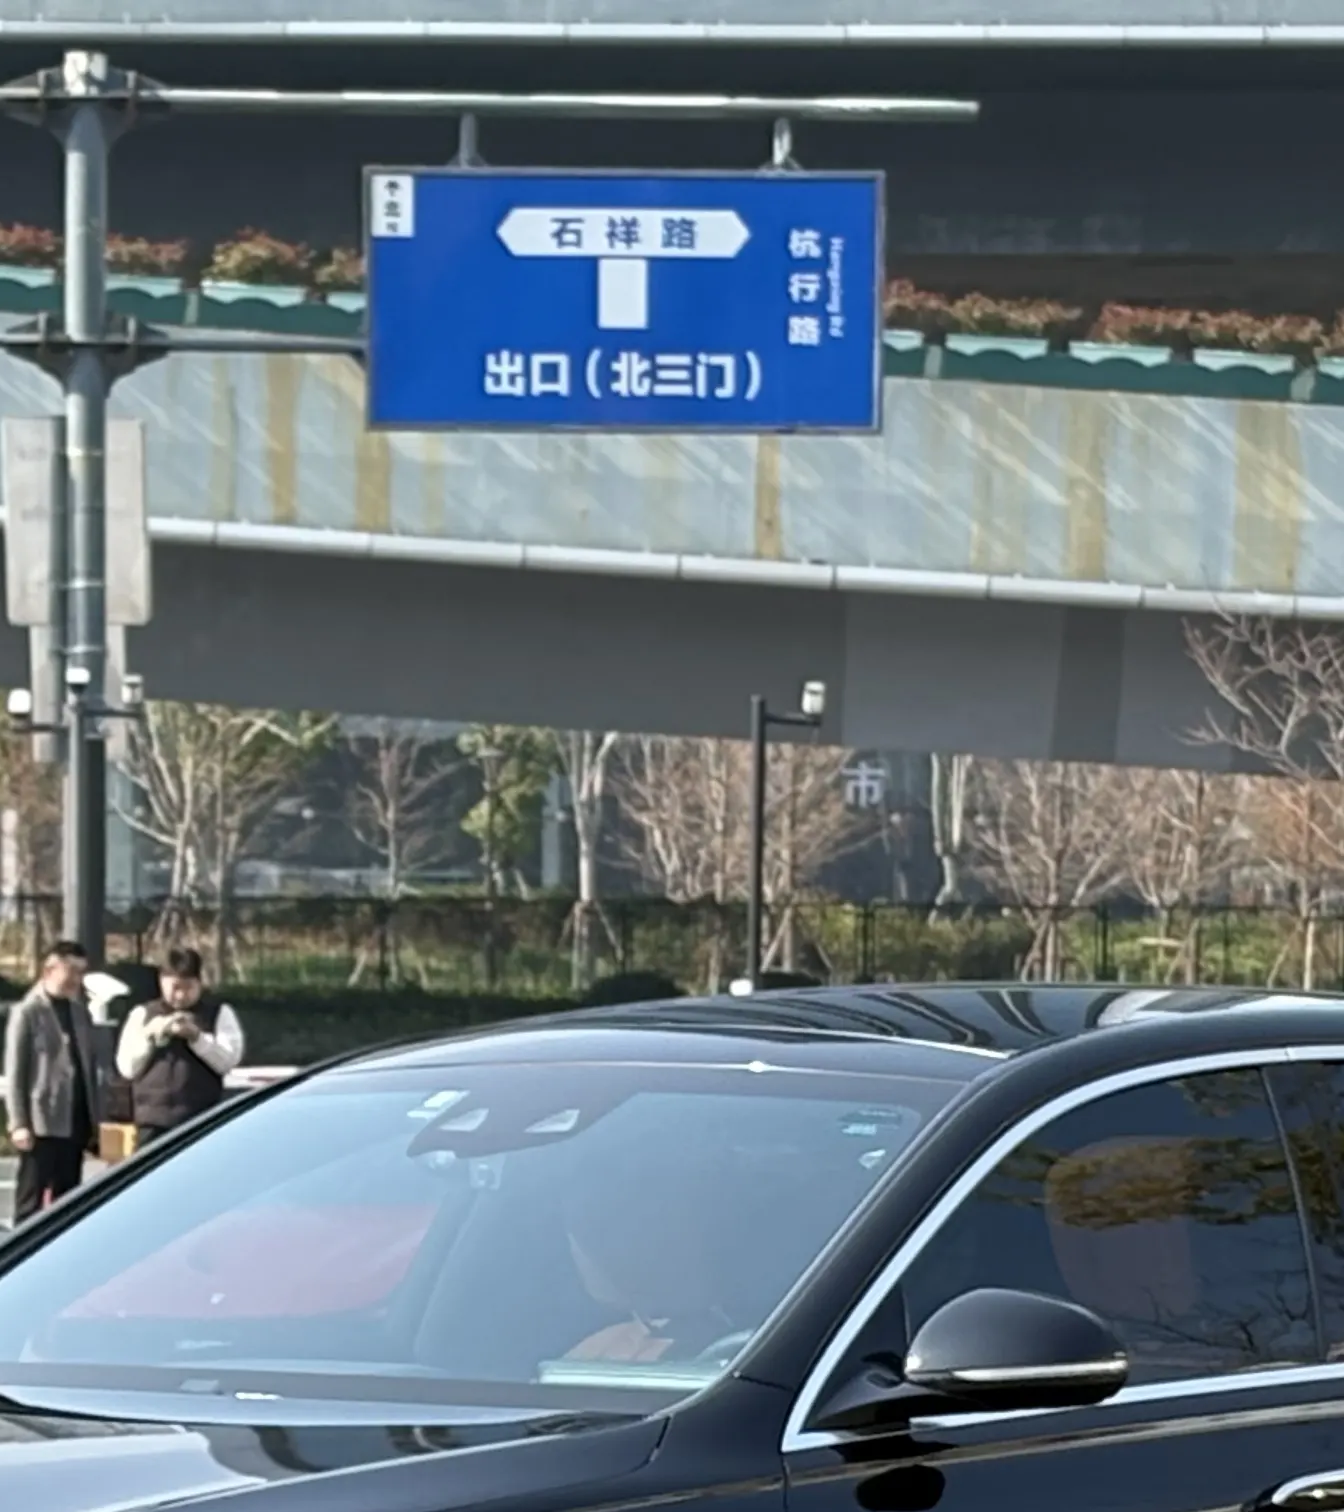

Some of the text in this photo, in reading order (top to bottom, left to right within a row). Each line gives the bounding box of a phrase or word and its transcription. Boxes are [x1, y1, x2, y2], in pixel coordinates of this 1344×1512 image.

[550, 216, 697, 250] 石祥路
[484, 348, 762, 400] 出口（北三门）
[841, 760, 885, 808] 市
